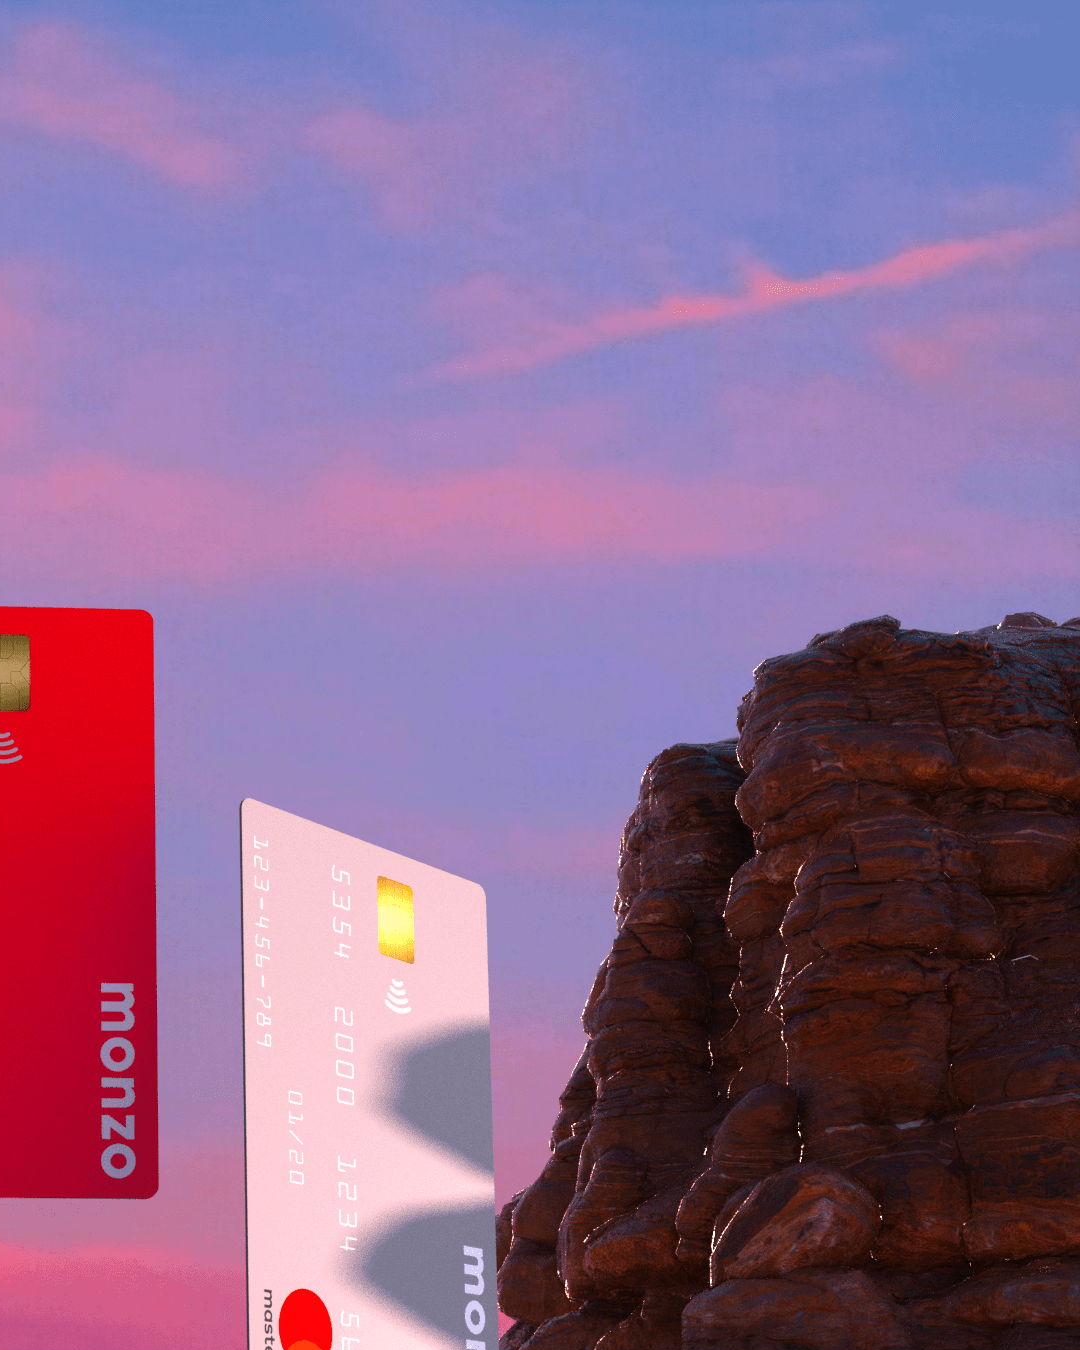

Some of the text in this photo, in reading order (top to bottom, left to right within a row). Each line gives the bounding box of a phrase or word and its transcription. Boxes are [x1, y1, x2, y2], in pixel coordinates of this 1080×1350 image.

[253, 836, 272, 1048] 123-456-789
[331, 864, 352, 959] 5354
[100, 982, 136, 1179] monzo
[334, 1006, 355, 1106] 2000
[287, 1090, 305, 1186] 01/20
[336, 1155, 358, 1251] 1234
